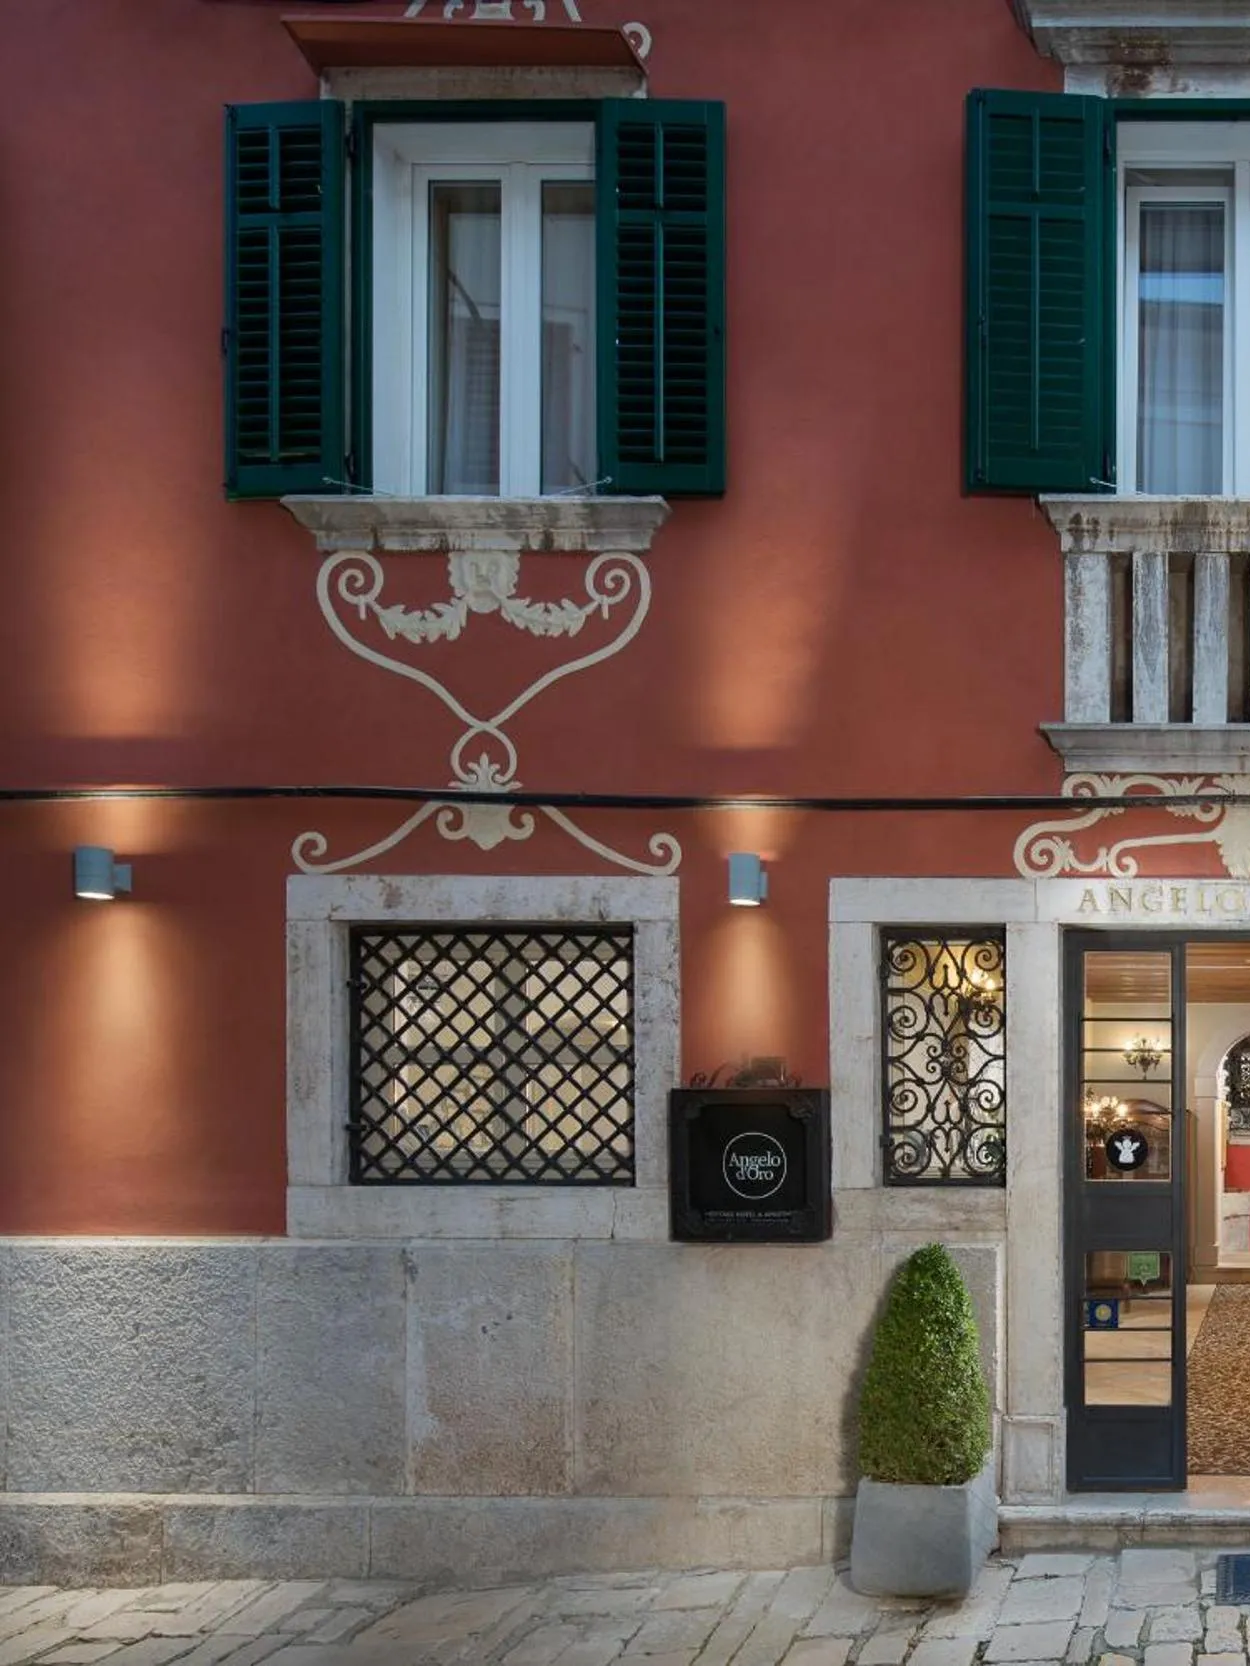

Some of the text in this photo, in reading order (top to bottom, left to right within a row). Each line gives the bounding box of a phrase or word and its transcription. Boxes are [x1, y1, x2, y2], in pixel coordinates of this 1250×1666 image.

[1076, 886, 1243, 914] ANGELO
[728, 1151, 781, 1169] Angelo
[735, 1165, 774, 1180] d'Oro
